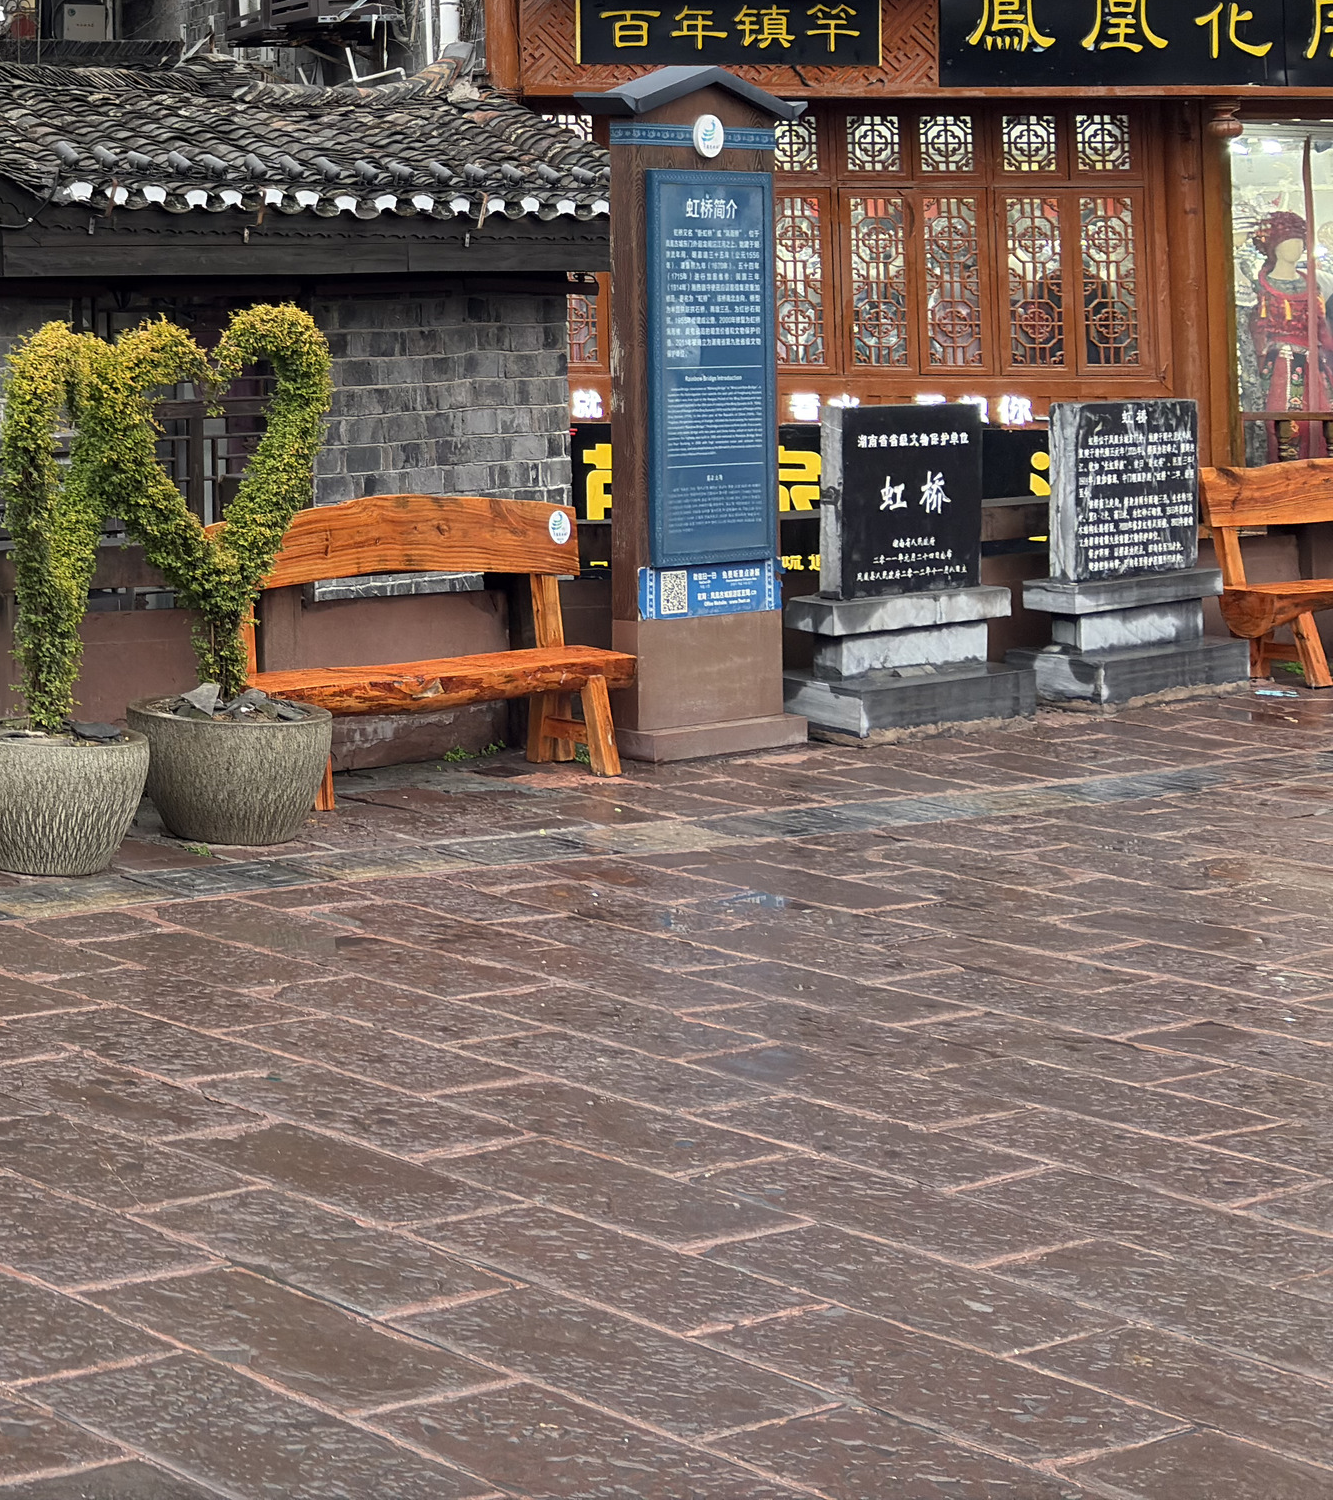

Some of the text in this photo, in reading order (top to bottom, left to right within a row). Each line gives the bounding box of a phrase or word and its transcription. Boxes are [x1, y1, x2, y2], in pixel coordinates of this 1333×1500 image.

[598, 3, 861, 52] 百年镇竿
[685, 198, 738, 220] 虹桥简介
[1121, 409, 1148, 424] 虹桥
[857, 431, 970, 449] 湖南省省级文物保护单位
[879, 470, 952, 514] 虹桥
[891, 536, 936, 548] 湖南省人民政府
